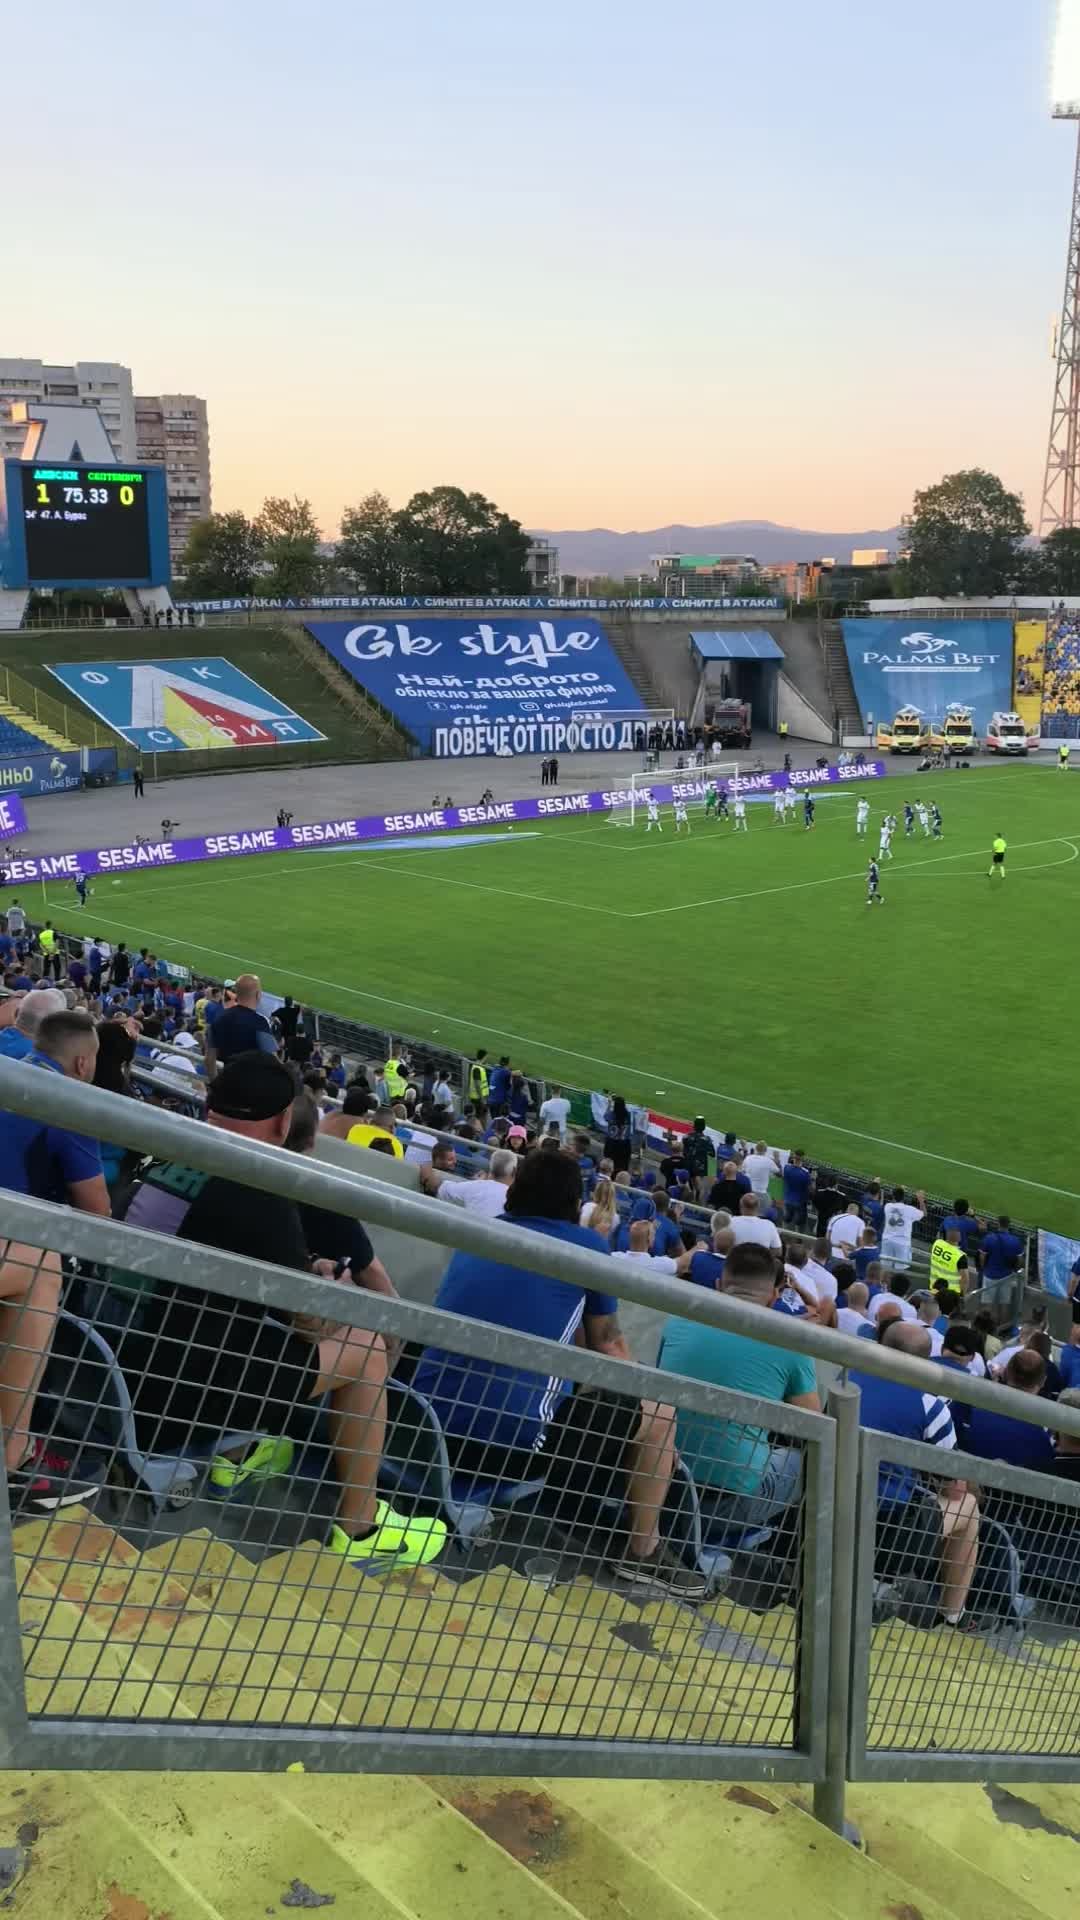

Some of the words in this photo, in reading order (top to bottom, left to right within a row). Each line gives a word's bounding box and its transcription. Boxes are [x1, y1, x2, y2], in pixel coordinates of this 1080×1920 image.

[36, 484, 50, 503] 1
[63, 487, 108, 504] 75.33
[120, 485, 134, 505] 0
[360, 598, 406, 606] АТАКА!
[424, 598, 473, 607] СИНИТЕ
[475, 599, 484, 607] В
[485, 598, 531, 607] АТАКА!
[547, 599, 596, 608] СИНИТЕ
[599, 600, 607, 608] В
[671, 599, 721, 608] СИНИТЕ
[723, 600, 731, 608] В
[732, 599, 777, 608] АТАКА!
[344, 624, 442, 660] Gk
[459, 621, 600, 668] style
[397, 672, 600, 689] Най-доброто
[395, 686, 467, 699] облекло
[470, 690, 489, 700] за
[492, 688, 556, 700] вашата
[557, 682, 617, 698] фирма
[435, 724, 511, 756] ПОВЕЧЕ
[513, 722, 536, 752] ОТ
[540, 722, 615, 752] ПРОСТО
[788, 769, 831, 786] SESAME
[838, 763, 878, 778] SESAME
[728, 775, 773, 792] SESAME
[458, 803, 516, 822] SESAME
[537, 794, 592, 814] SESAME
[384, 811, 447, 832] SESAME
[291, 821, 359, 843] SESAME
[205, 830, 278, 854] SESAME
[98, 843, 176, 868] SESAME
[933, 1245, 953, 1261] BG
